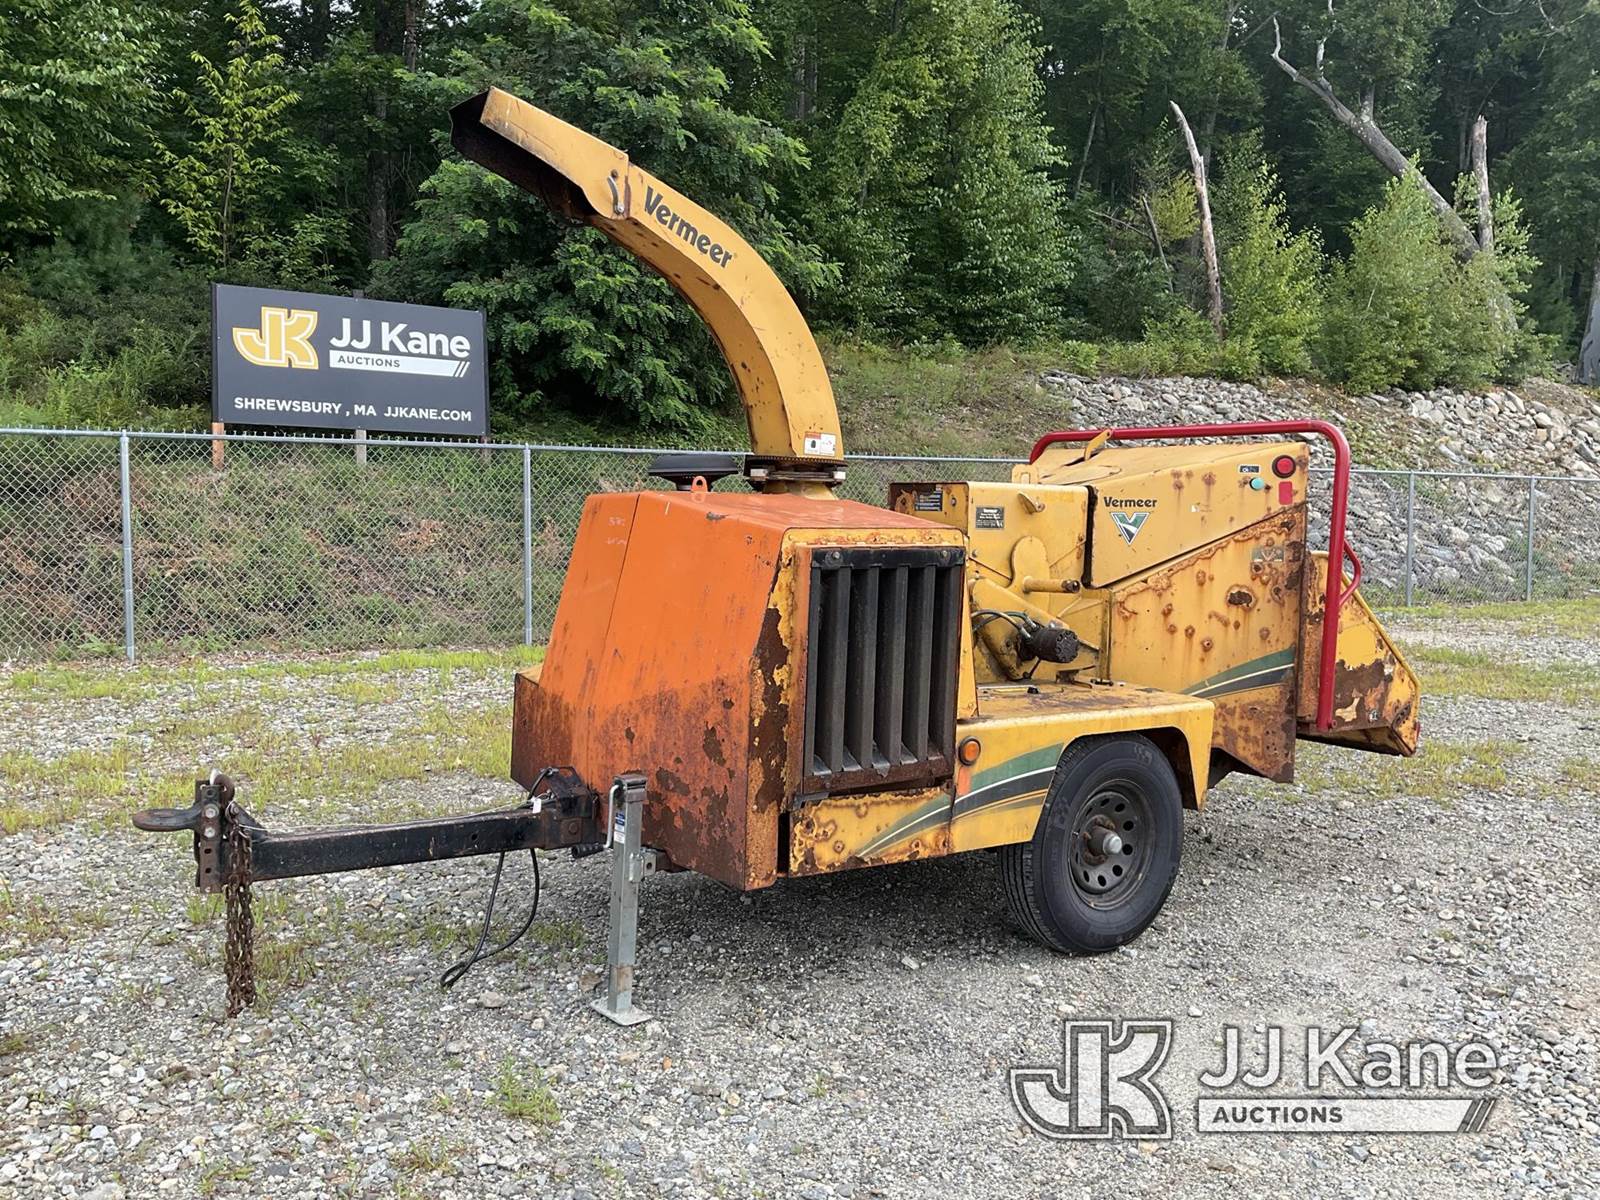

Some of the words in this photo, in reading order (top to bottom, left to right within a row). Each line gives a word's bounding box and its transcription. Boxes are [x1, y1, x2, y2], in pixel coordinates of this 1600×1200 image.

[644, 185, 733, 268] Vermeer
[329, 317, 371, 350] JJ
[381, 321, 471, 358] Kane
[337, 355, 400, 368] AUCTIONS
[234, 396, 342, 415] SHREWSBURY
[354, 404, 377, 417] MA
[383, 405, 472, 422] JJKANE.COM
[1103, 496, 1158, 508] Vermeer
